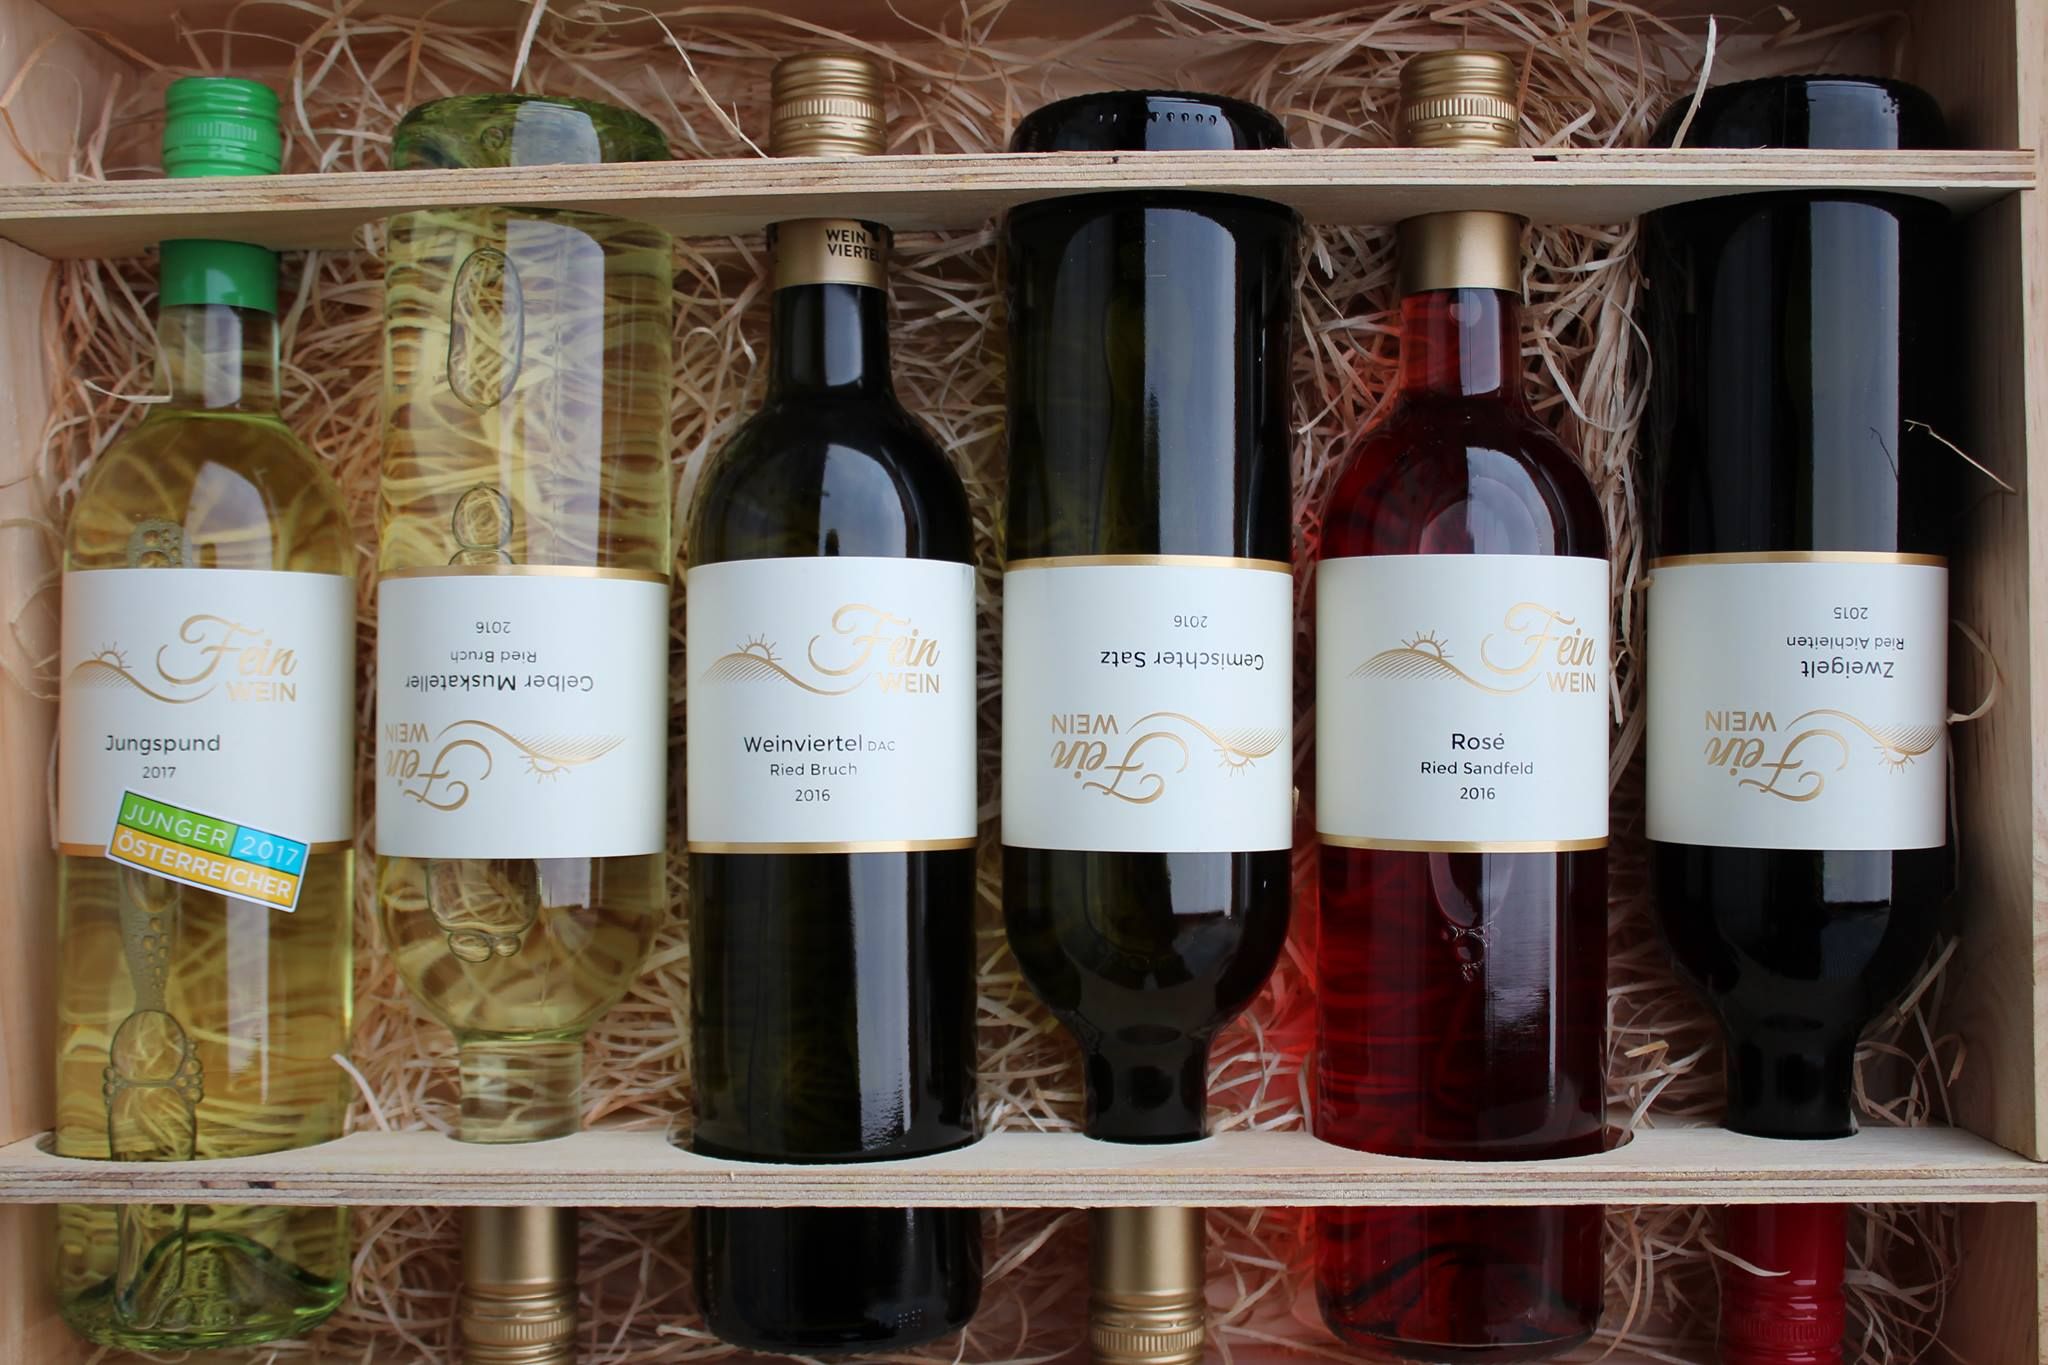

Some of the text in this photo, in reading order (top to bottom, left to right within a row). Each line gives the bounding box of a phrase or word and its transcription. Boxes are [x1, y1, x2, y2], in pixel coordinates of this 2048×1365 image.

[826, 229, 866, 244] WEIN
[1173, 615, 1208, 628] 2016
[1833, 606, 1868, 620] 2015
[475, 621, 512, 635] 2016
[1480, 601, 1597, 675] Fein
[156, 614, 297, 685] Fein
[807, 603, 940, 677] Fein
[1786, 635, 1905, 650] Ried Aichleiten
[450, 650, 538, 663] Ried Bruch
[1100, 651, 1265, 671] Gemischter Satz
[1800, 656, 1894, 678] Zweigelt
[227, 681, 296, 703] WEIN
[404, 674, 595, 693] Gelber Muskateller
[878, 673, 940, 694] WEIN
[1546, 671, 1597, 693] WEIN
[1051, 713, 1119, 735] WEIN
[1705, 711, 1777, 732] WEIN
[385, 723, 429, 743] WEIN
[1451, 732, 1505, 750] Rosé
[105, 735, 220, 755] Jungspund
[743, 735, 896, 753] Weinviertel DAC
[142, 766, 177, 779] 2017
[385, 739, 493, 812] Fein
[770, 763, 858, 777] Ried Bruch
[1050, 731, 1190, 805] Fein
[1420, 761, 1535, 775] Ried Sandfeld
[1704, 729, 1849, 802] Fein
[795, 789, 831, 802] 2016
[1459, 787, 1496, 801] 2016
[125, 803, 300, 866] JUNGER 2017
[115, 831, 292, 898] ÖSTERREICHER
